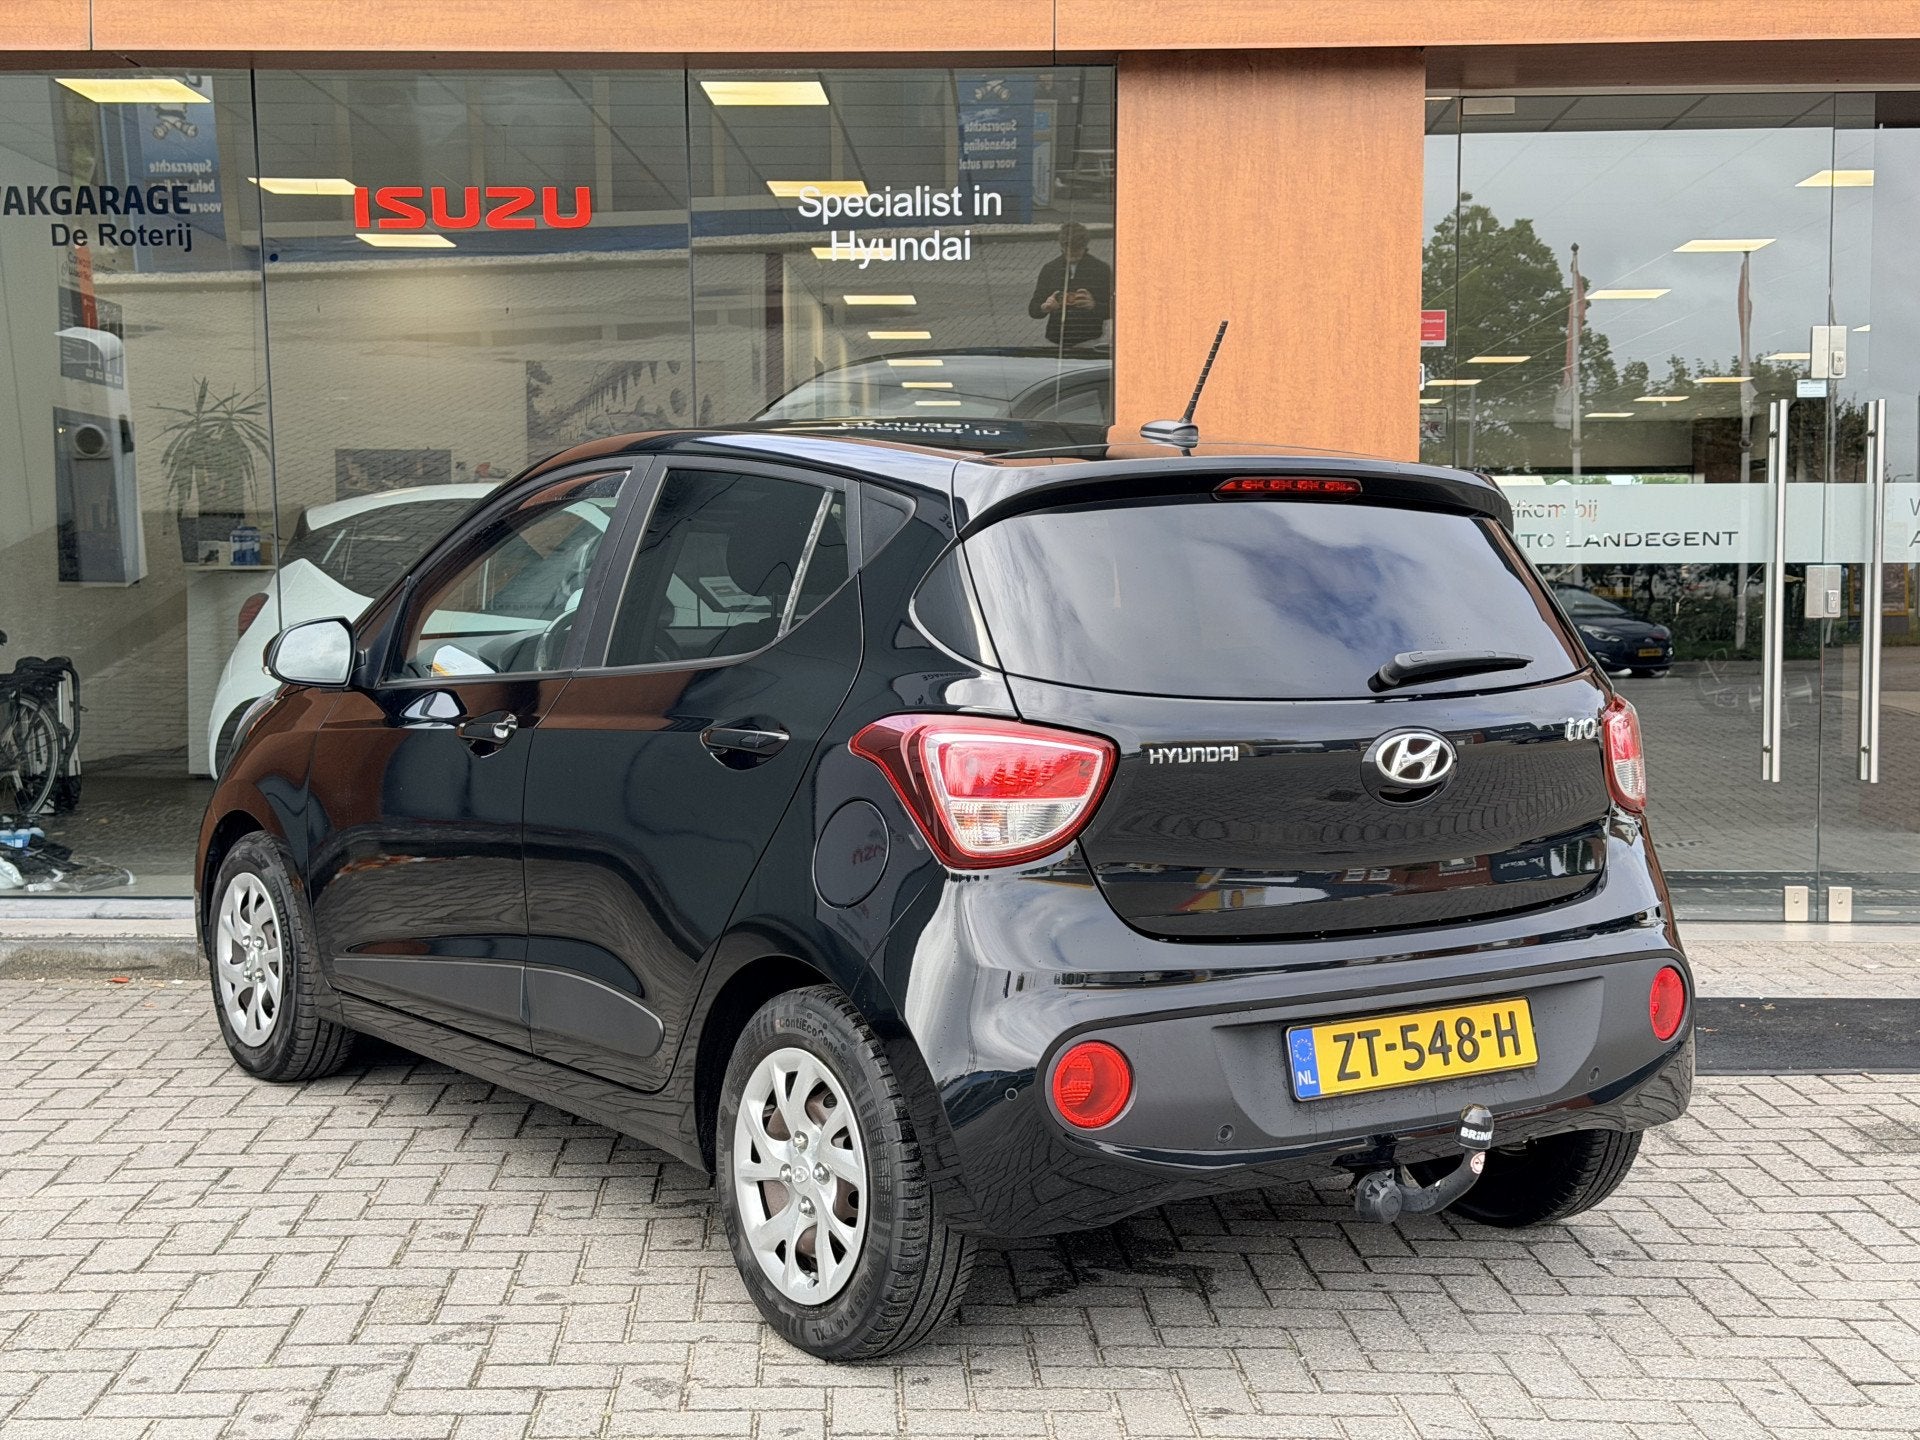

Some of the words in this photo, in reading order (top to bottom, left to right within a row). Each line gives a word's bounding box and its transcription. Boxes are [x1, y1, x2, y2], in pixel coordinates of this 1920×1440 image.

[0, 186, 191, 216] AKGARAGE
[354, 186, 592, 229] ISUZU
[797, 185, 963, 226] Specialist
[974, 184, 1002, 217] in
[51, 223, 88, 247] De
[98, 223, 193, 253] Roterij
[830, 229, 972, 270] Hyundai
[1512, 499, 1566, 519] lkom
[1575, 499, 1598, 522] bij
[1515, 533, 1555, 549] TO
[1565, 530, 1739, 548] LANDEGENT
[1566, 716, 1597, 742] i10
[1148, 745, 1239, 765] HYUNDAI
[1332, 1010, 1522, 1083] ZT-548-H
[1297, 1070, 1317, 1088] NL
